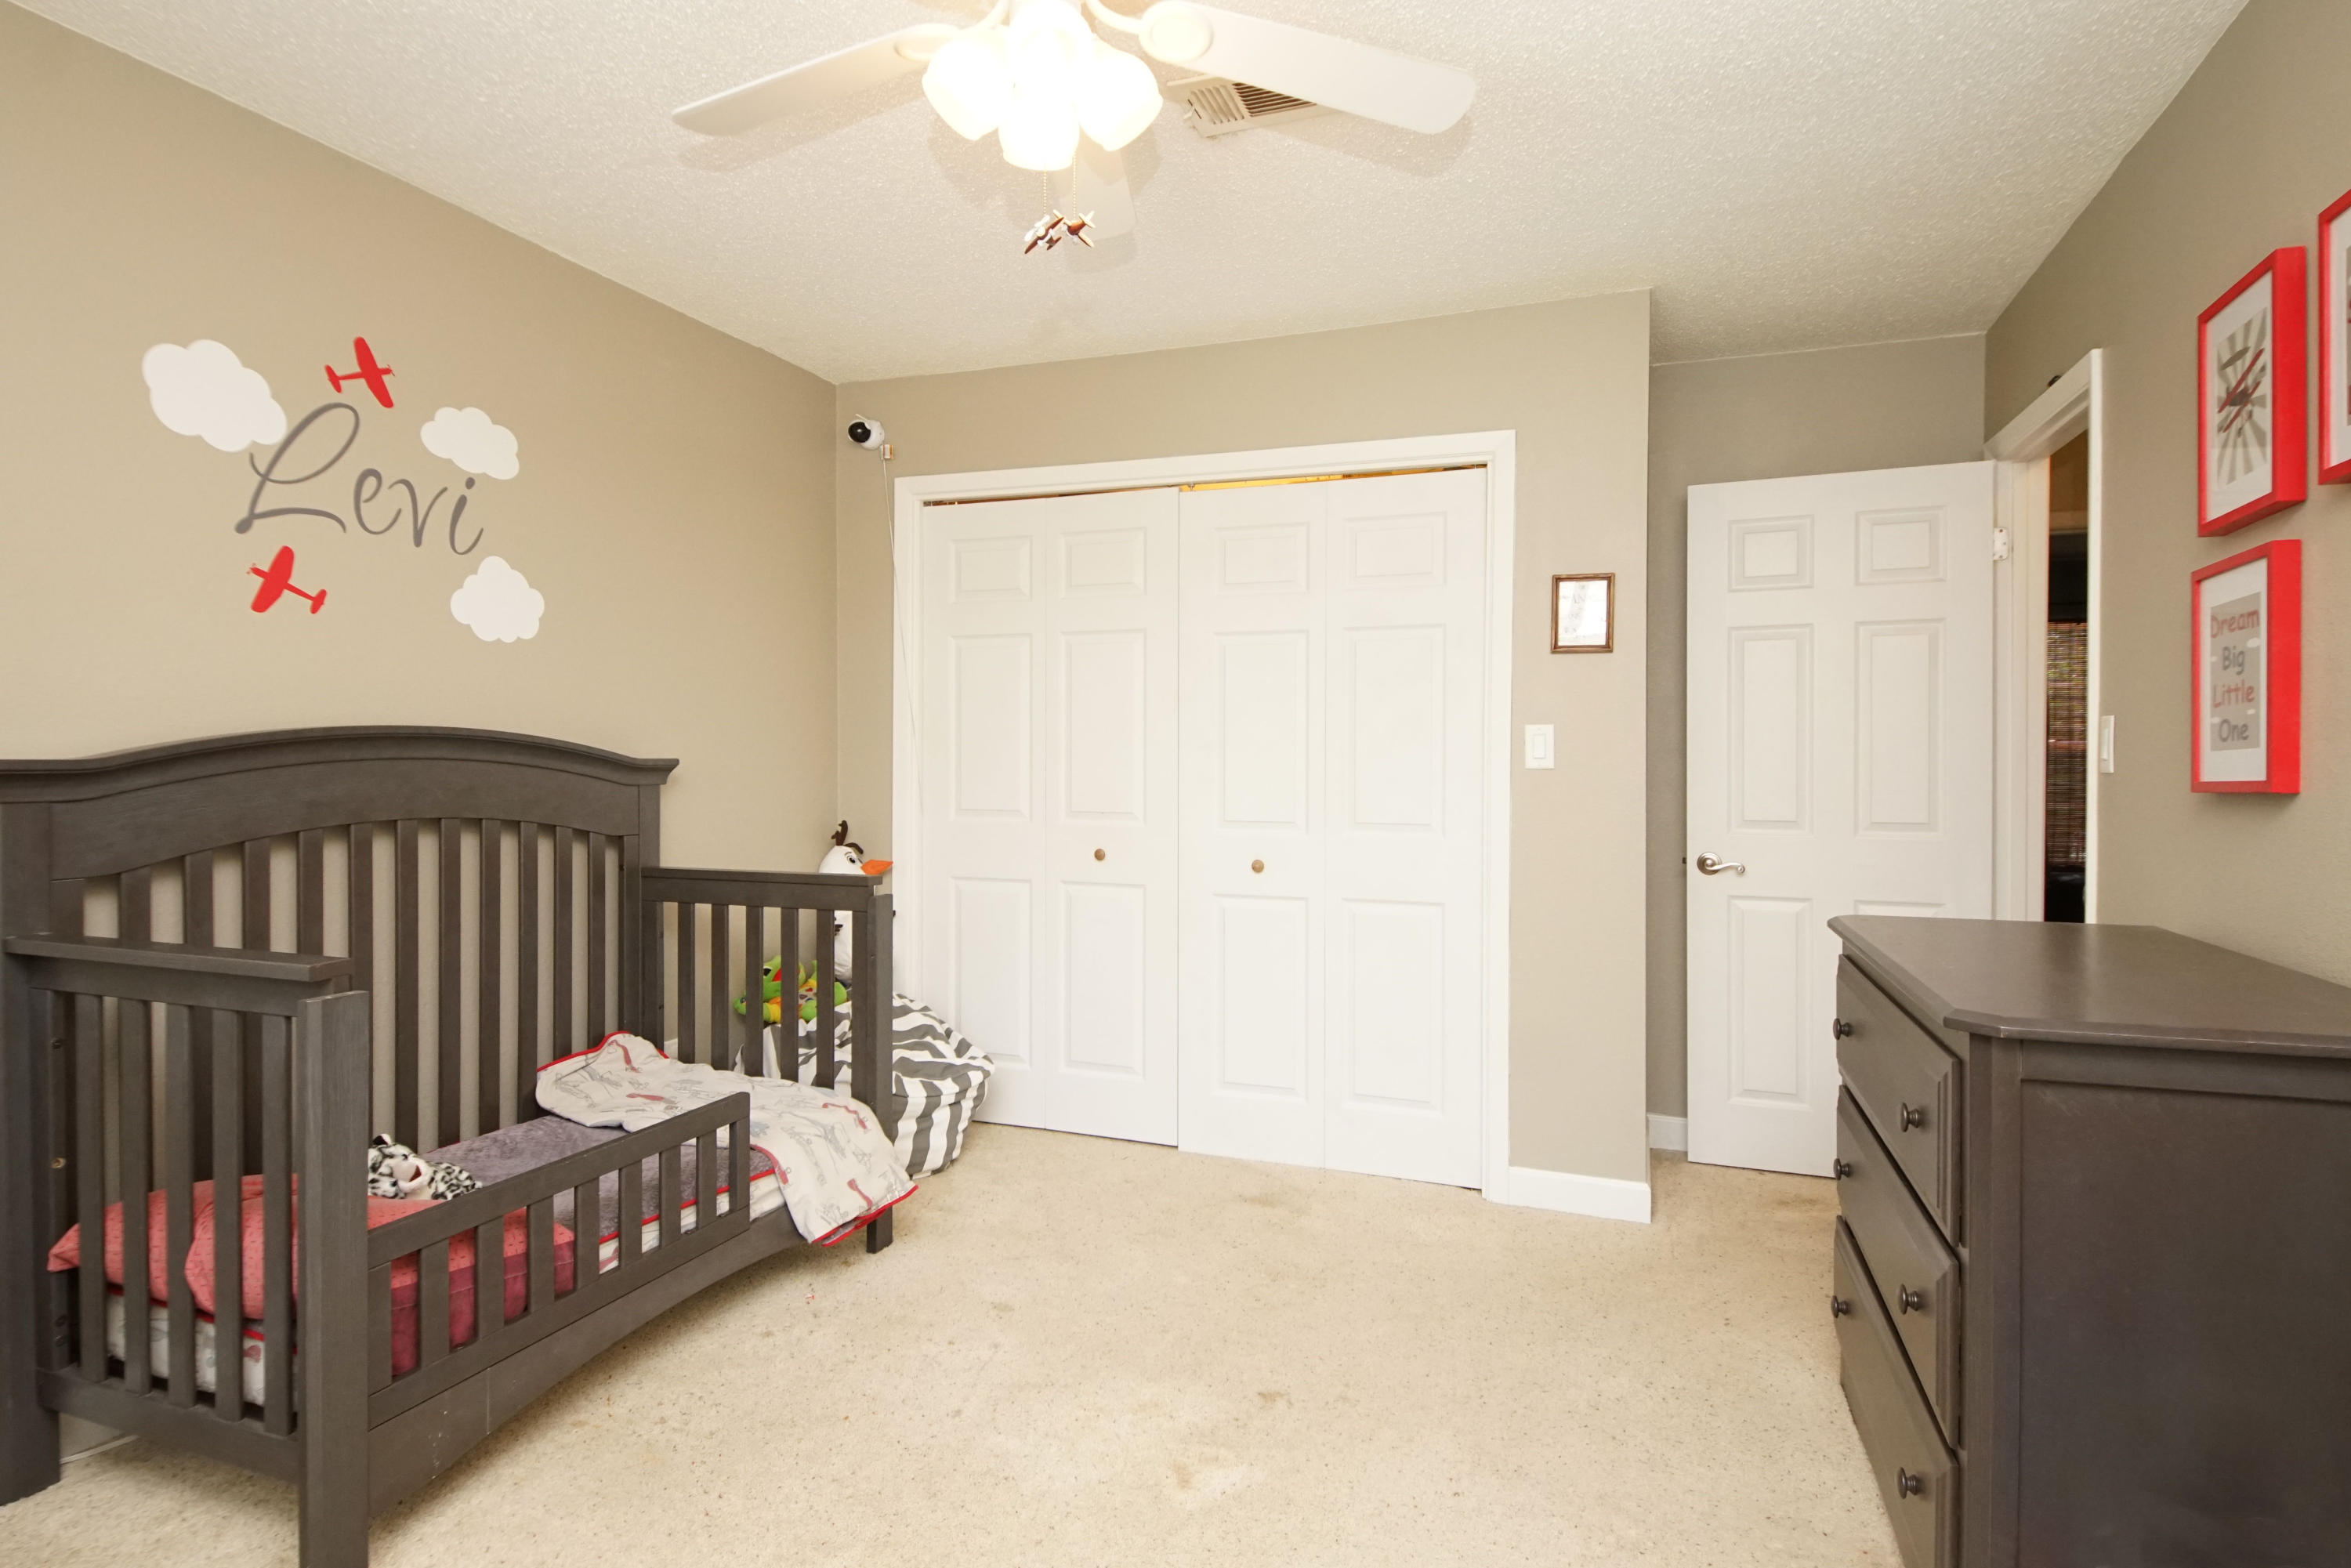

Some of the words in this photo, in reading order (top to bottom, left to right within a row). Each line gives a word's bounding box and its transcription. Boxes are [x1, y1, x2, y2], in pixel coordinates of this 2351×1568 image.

[234, 402, 484, 555] Levi
[2211, 609, 2259, 639] Dream
[2222, 646, 2245, 675] Big
[2213, 679, 2255, 708] Little
[2219, 719, 2249, 742] One
